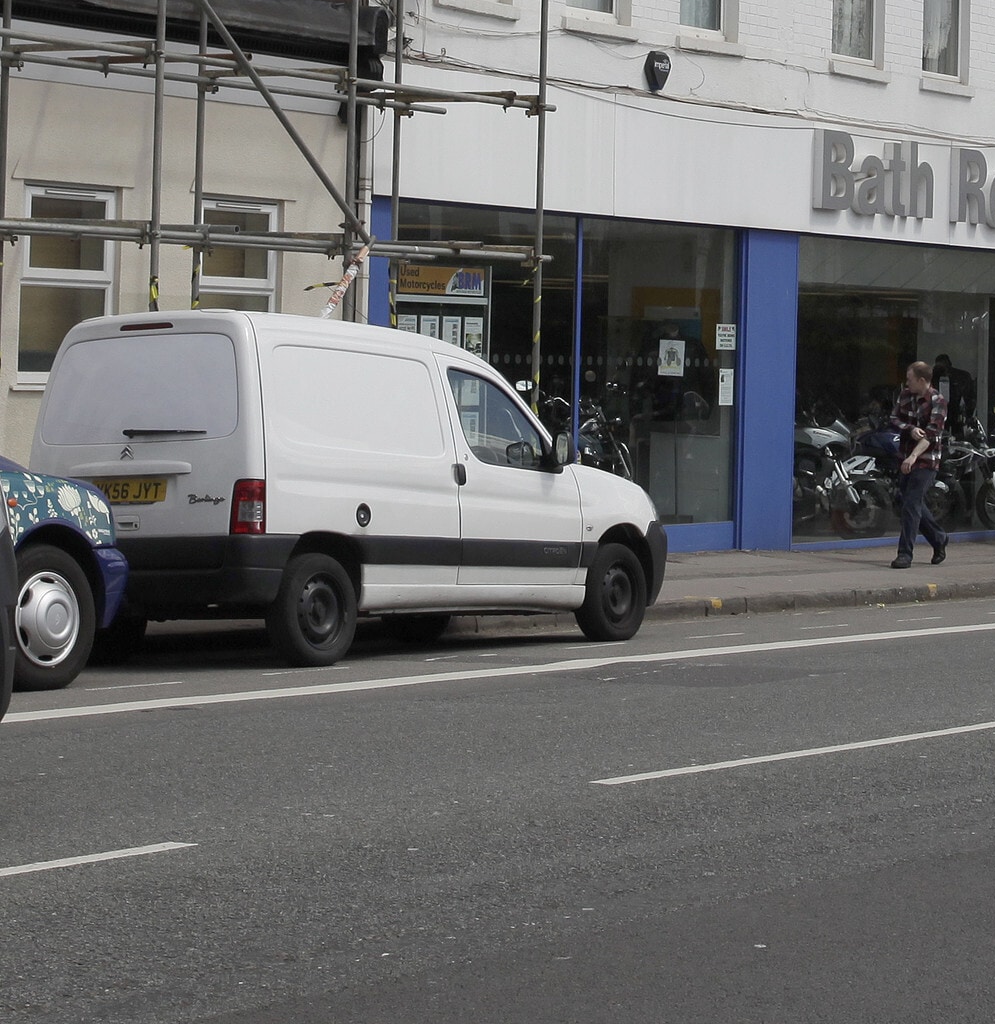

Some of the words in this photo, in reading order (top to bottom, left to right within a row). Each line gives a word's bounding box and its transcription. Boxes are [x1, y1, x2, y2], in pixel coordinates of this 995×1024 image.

[813, 128, 934, 219] Bath
[400, 263, 419, 276] Used
[400, 279, 445, 291] Motorcycles
[458, 272, 481, 290] BRM
[133, 483, 161, 498] JYT
